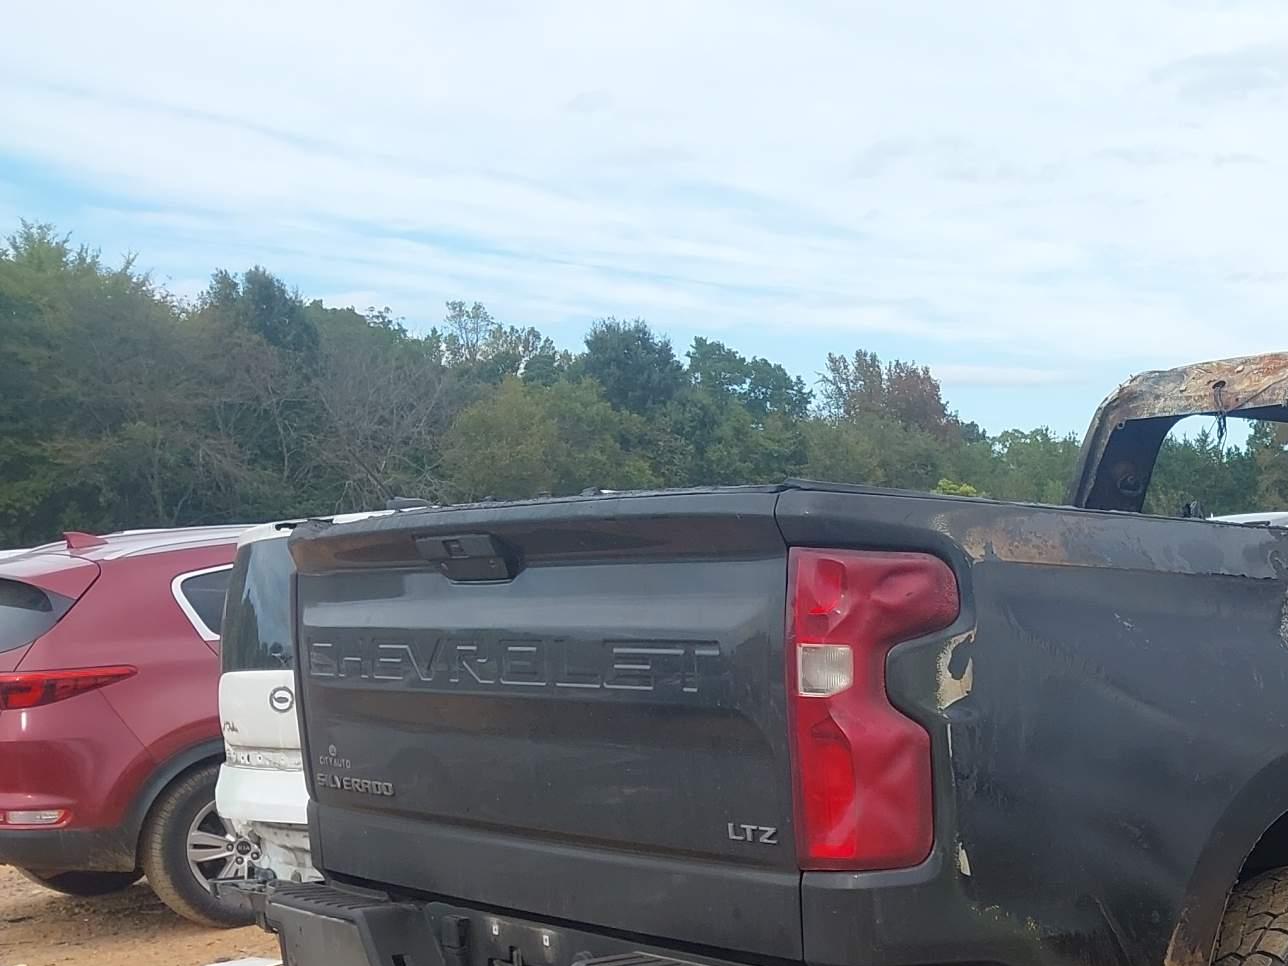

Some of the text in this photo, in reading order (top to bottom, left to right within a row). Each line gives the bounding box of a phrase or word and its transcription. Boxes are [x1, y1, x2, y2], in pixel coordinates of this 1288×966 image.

[308, 638, 721, 693] CHEVROLET
[317, 772, 395, 796] SILVERADO
[727, 822, 778, 845] LTZ
